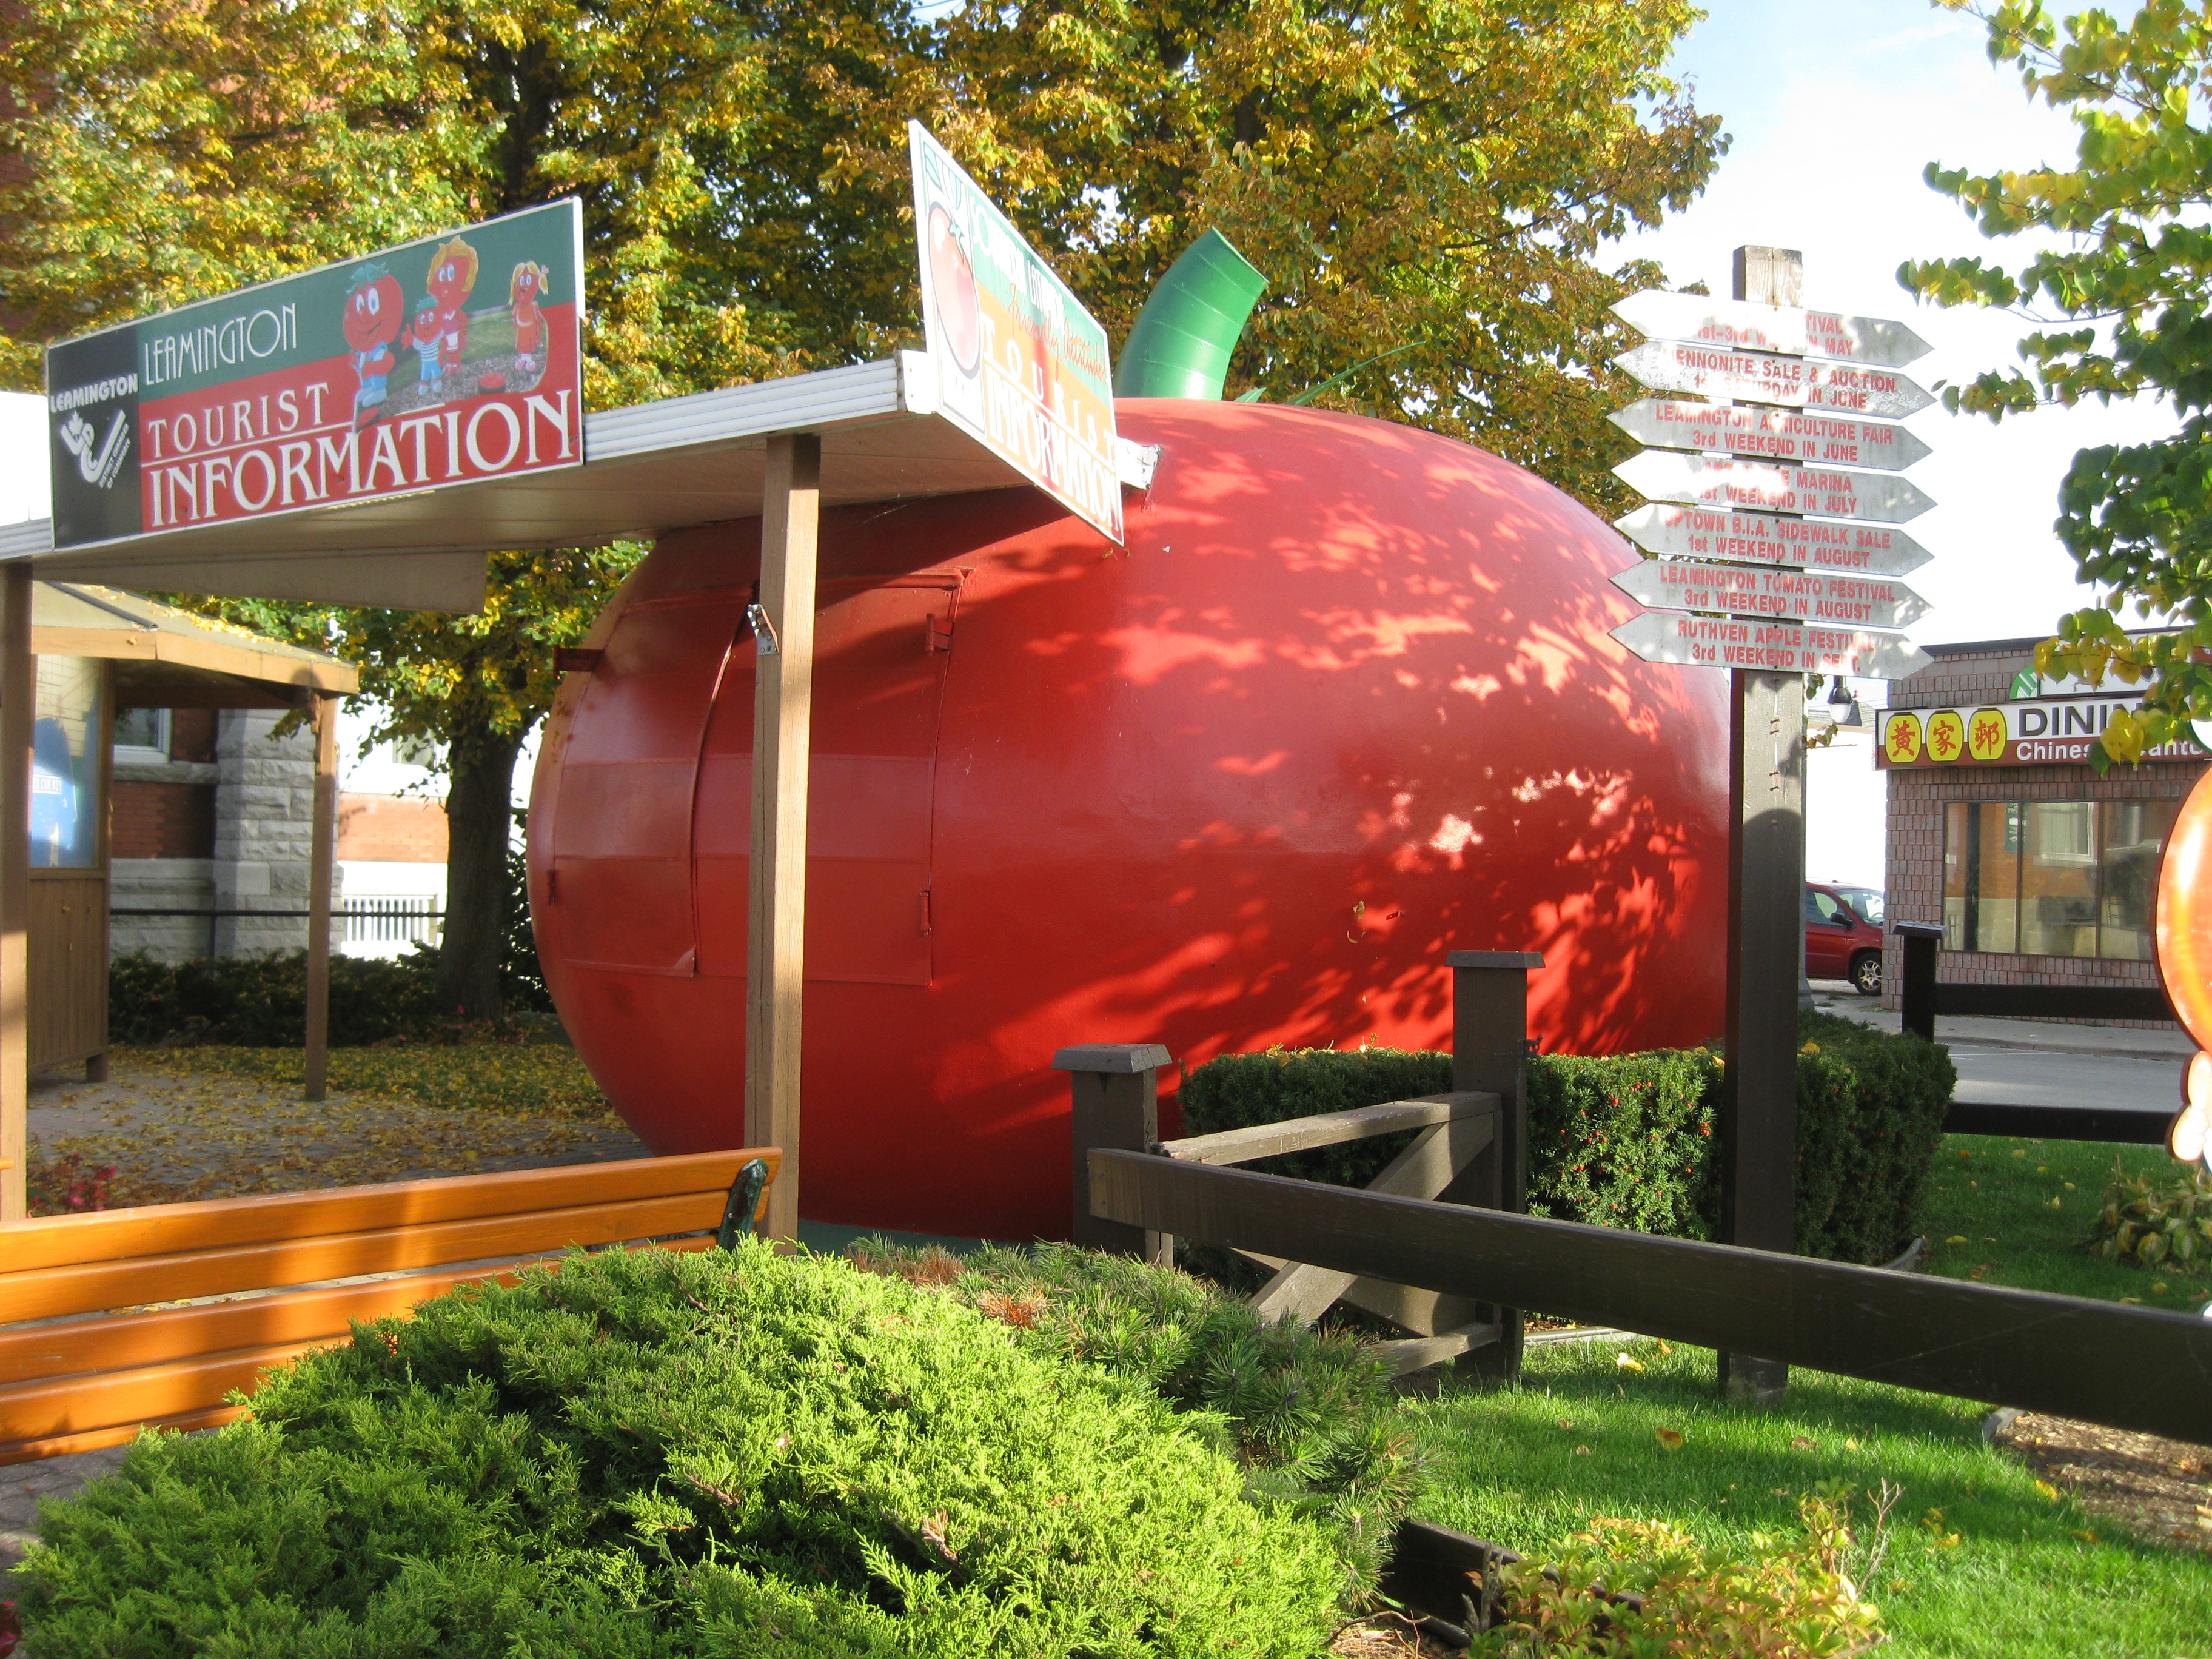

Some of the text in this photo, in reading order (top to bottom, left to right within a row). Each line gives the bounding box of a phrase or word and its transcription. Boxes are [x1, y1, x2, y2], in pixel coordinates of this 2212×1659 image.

[144, 301, 297, 386] LEAMINGTON
[1825, 338, 1854, 355] MAY
[50, 373, 138, 413] LEAMINGTON
[979, 312, 1116, 465] TOURIST
[1694, 374, 1708, 389] 1s
[1808, 386, 1822, 402] IN
[1830, 392, 1867, 410] JUNE
[1763, 361, 1801, 381] SALE
[1809, 366, 1818, 383] &
[1829, 369, 1896, 393] AUCTION
[148, 383, 329, 458] TOURIST
[1656, 404, 1753, 428] LEAMINGTON
[1863, 426, 1893, 444] FAIR
[150, 390, 575, 528] INFORMATION
[985, 364, 1121, 532] INFORMATION
[1692, 430, 1858, 461] 3rd WEEKEND IN JUNE
[1797, 471, 1852, 492] MARINA
[1726, 485, 1796, 508] WEEKEND
[1803, 494, 1817, 509] IN
[1824, 495, 1857, 513] JULY
[1665, 510, 1891, 549] UPTOWN B.I.A. SIDEWALK SALE
[1688, 534, 1870, 567] 1st WEEKEND IN AUGUST
[1660, 565, 1894, 602] LEAMINGTON TOMATO FESTIVAL
[1684, 589, 1872, 620] 3rd WEEKEND IN AUGUST
[1678, 620, 1875, 652] RUTHVEN APPLE FESTIVAL
[1692, 643, 1861, 672] 3rd WEEKEND IN SEPT.
[2016, 740, 2091, 761] Chines
